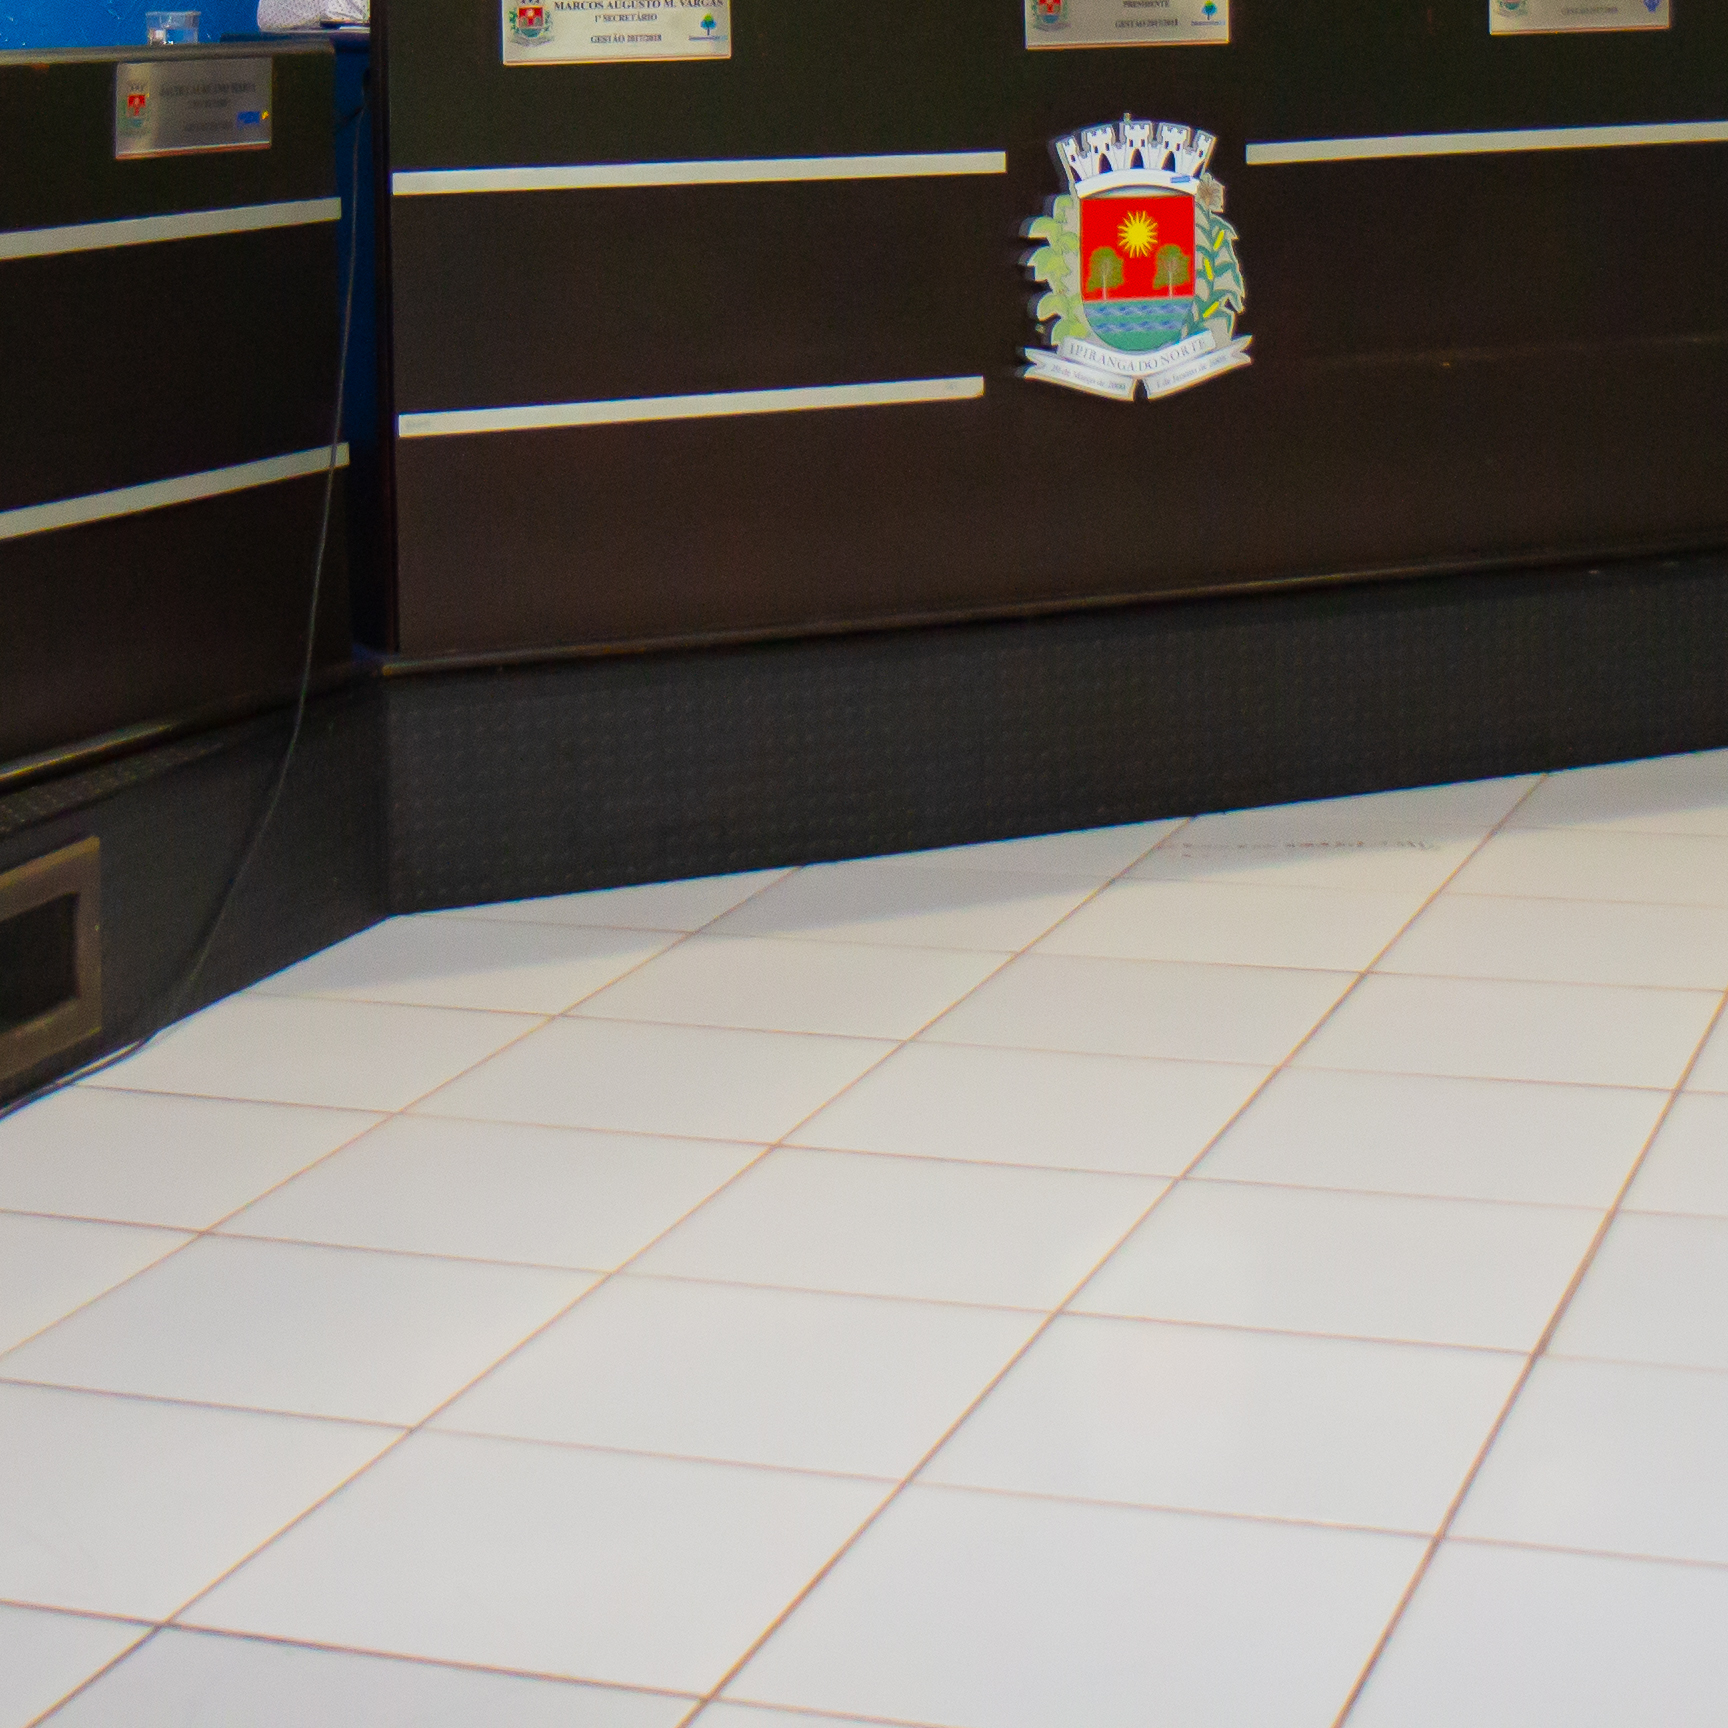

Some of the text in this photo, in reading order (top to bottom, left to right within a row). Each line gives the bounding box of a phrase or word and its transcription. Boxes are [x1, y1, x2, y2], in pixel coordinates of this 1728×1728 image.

[554, 1, 604, 11] MARCOS
[607, 0, 661, 10] AUGUSTO
[664, 0, 677, 8] M.
[1069, 338, 1206, 372] IPIRANGA DO NORTE
